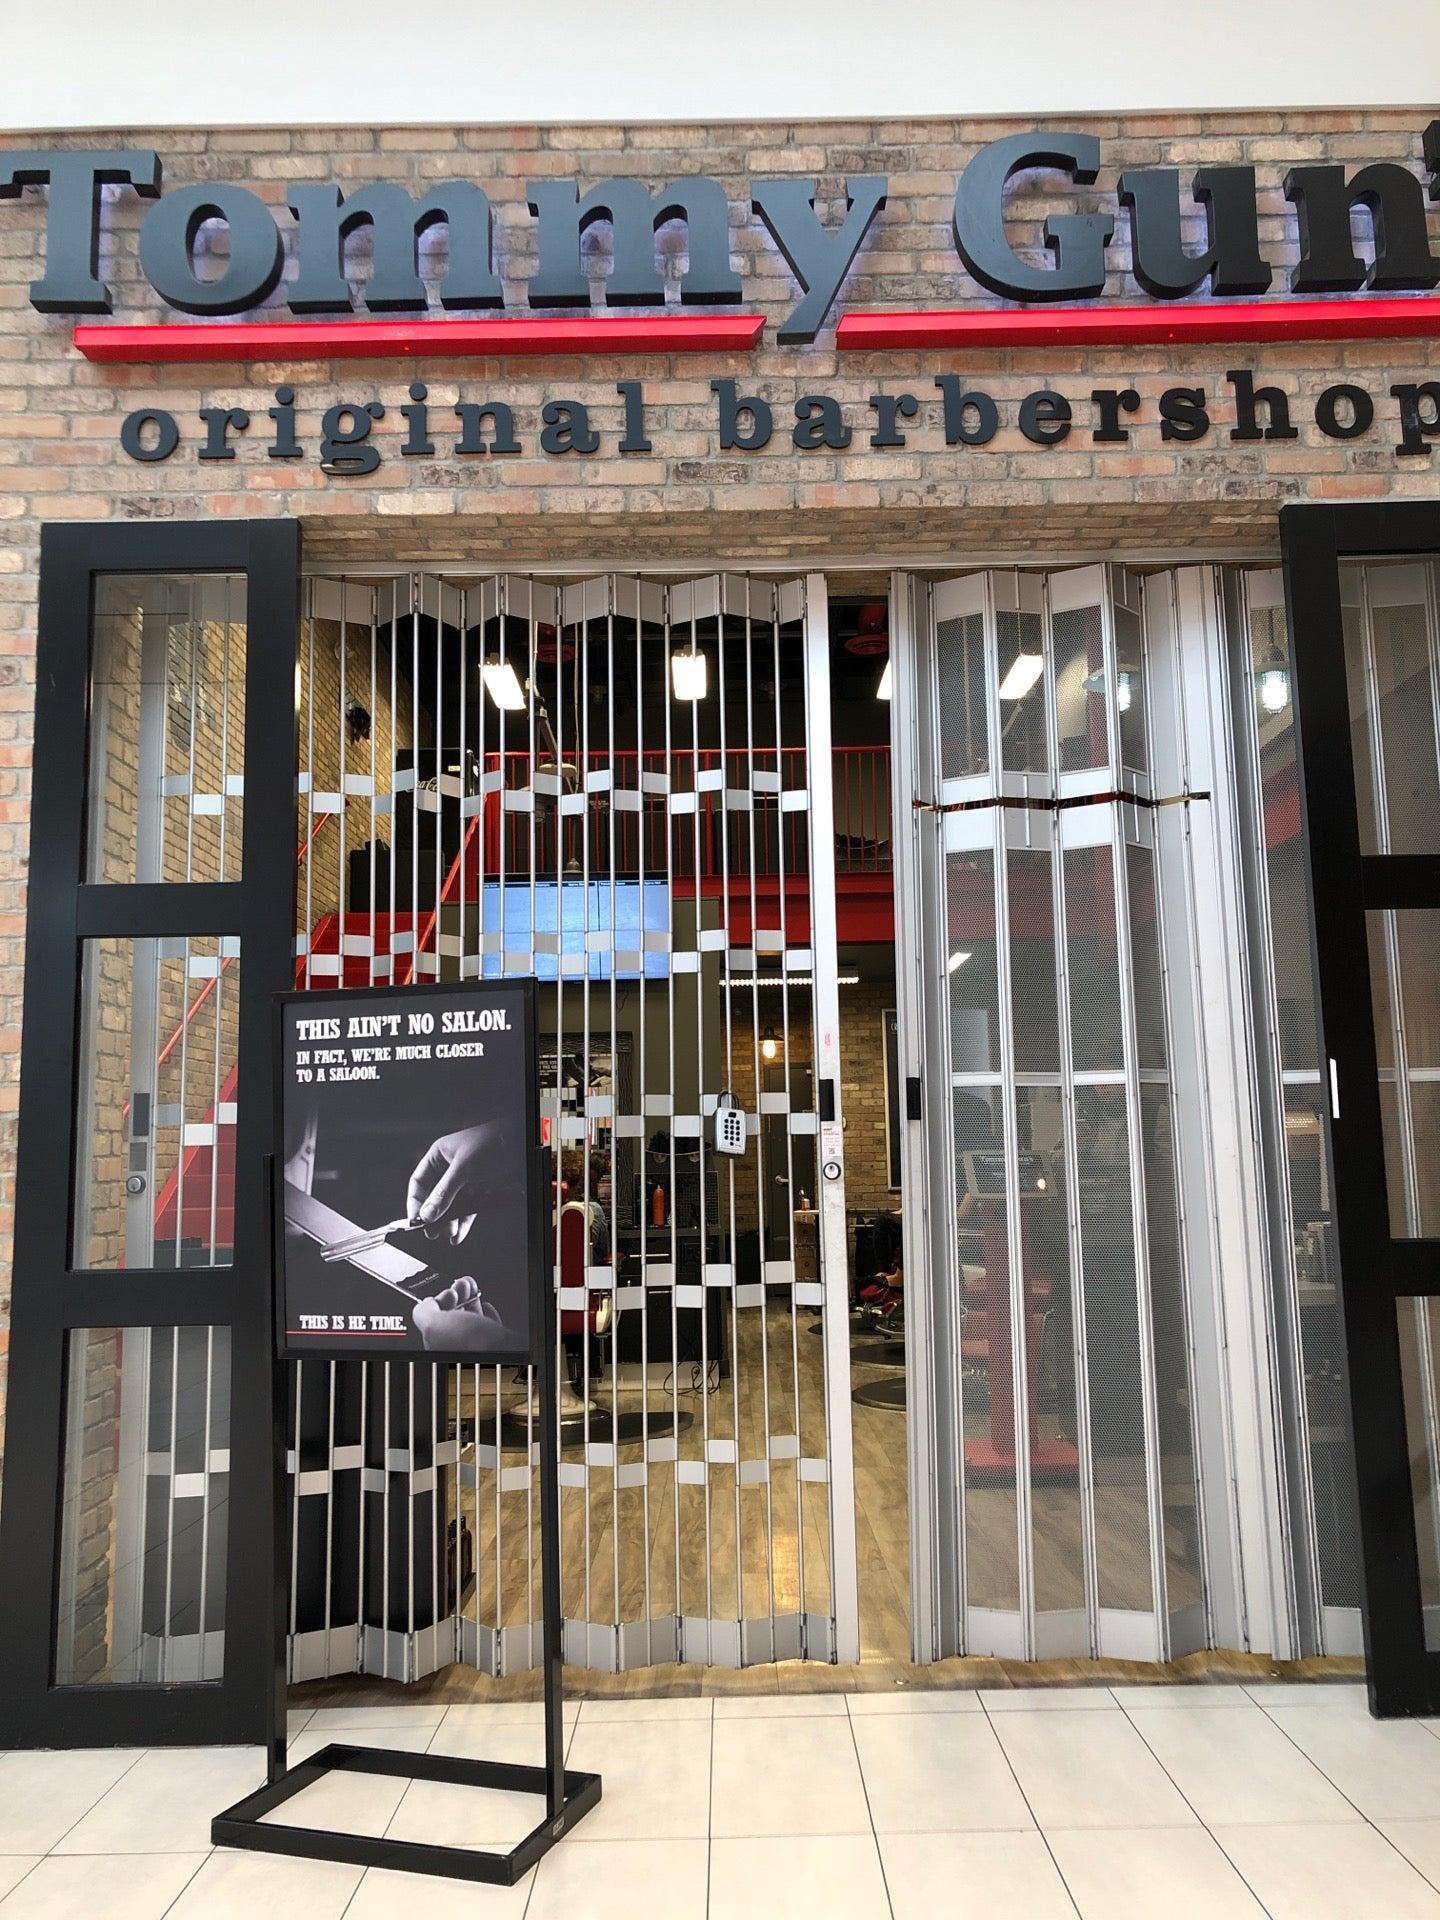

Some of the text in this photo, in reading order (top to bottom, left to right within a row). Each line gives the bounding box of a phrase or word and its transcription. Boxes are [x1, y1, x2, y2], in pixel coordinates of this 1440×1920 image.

[0, 150, 888, 346] Tommy
[120, 370, 1440, 477] original barbershop
[296, 1009, 512, 1041] THIS AIN'T NO SALON.
[296, 1042, 484, 1066] IN FACT, WE'RE MUCH CLOSER
[296, 1066, 381, 1083] TO A SALOON.
[299, 1315, 407, 1331] THIS IS HE TIME.
